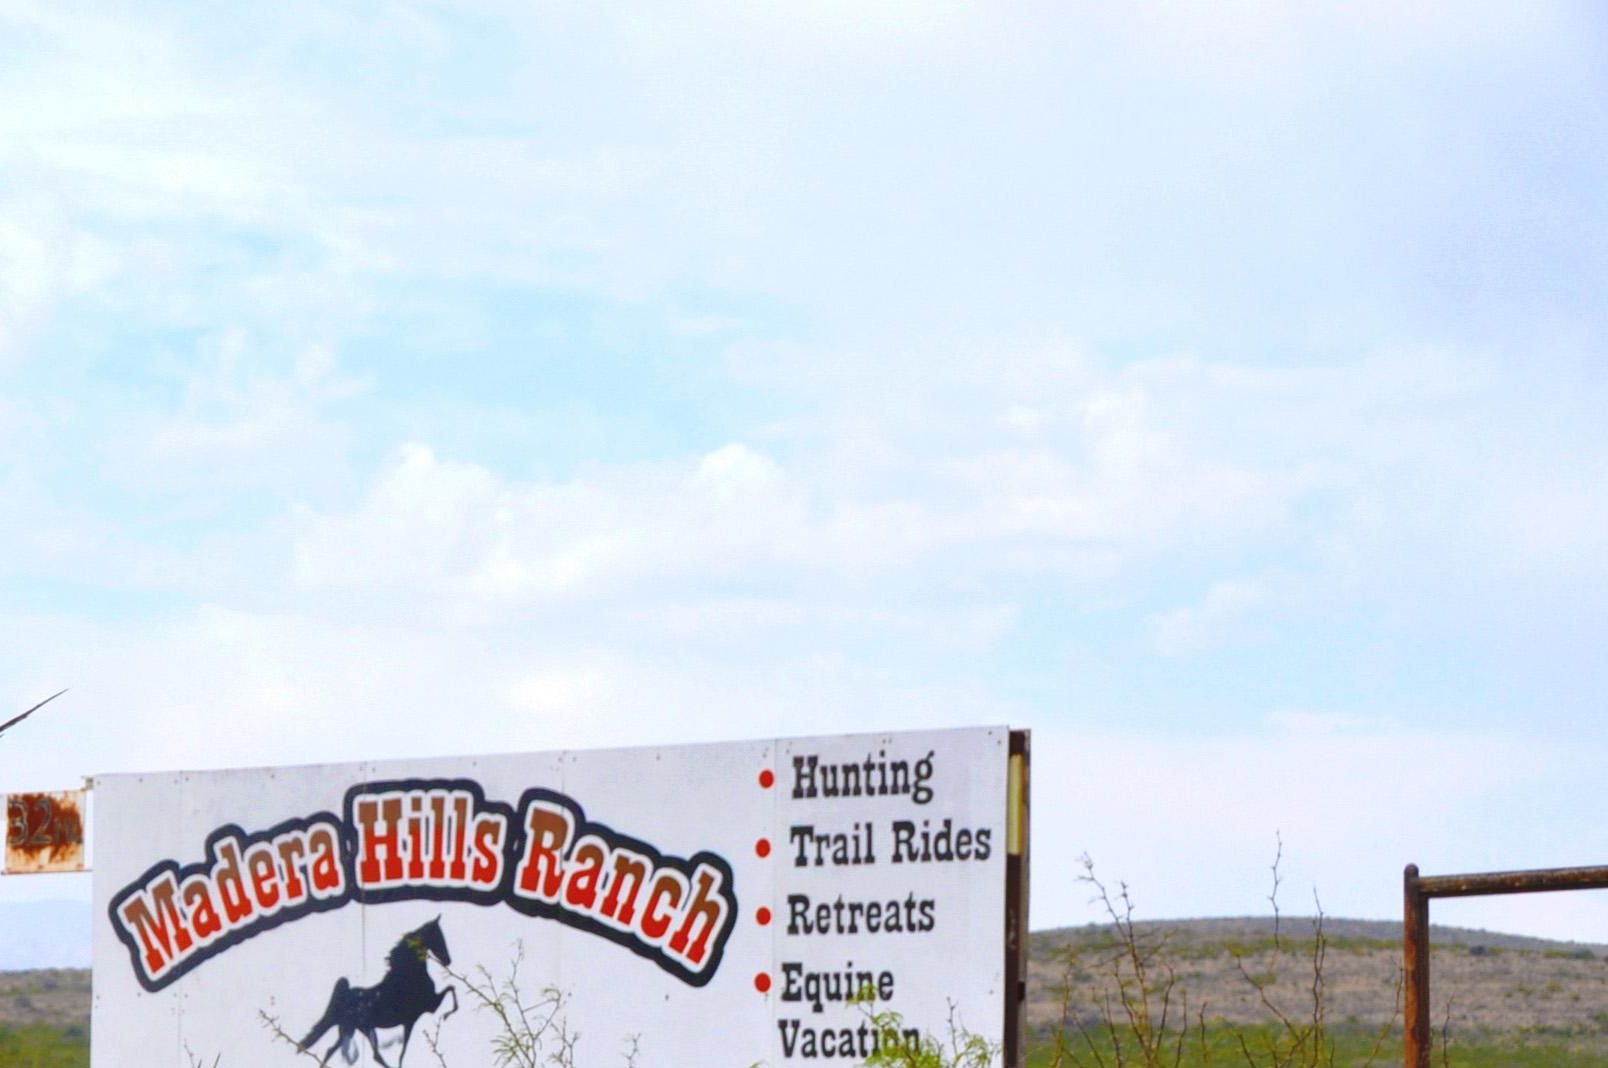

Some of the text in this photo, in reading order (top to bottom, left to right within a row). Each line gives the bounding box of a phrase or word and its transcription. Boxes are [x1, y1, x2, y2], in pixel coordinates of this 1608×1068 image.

[792, 750, 935, 804] Hunting
[790, 819, 992, 867] Trail Rides
[116, 786, 733, 983] Madera Hills Ranch
[787, 892, 935, 936] Retreats
[781, 961, 895, 1013] Equine
[778, 1018, 921, 1058] Vacation
